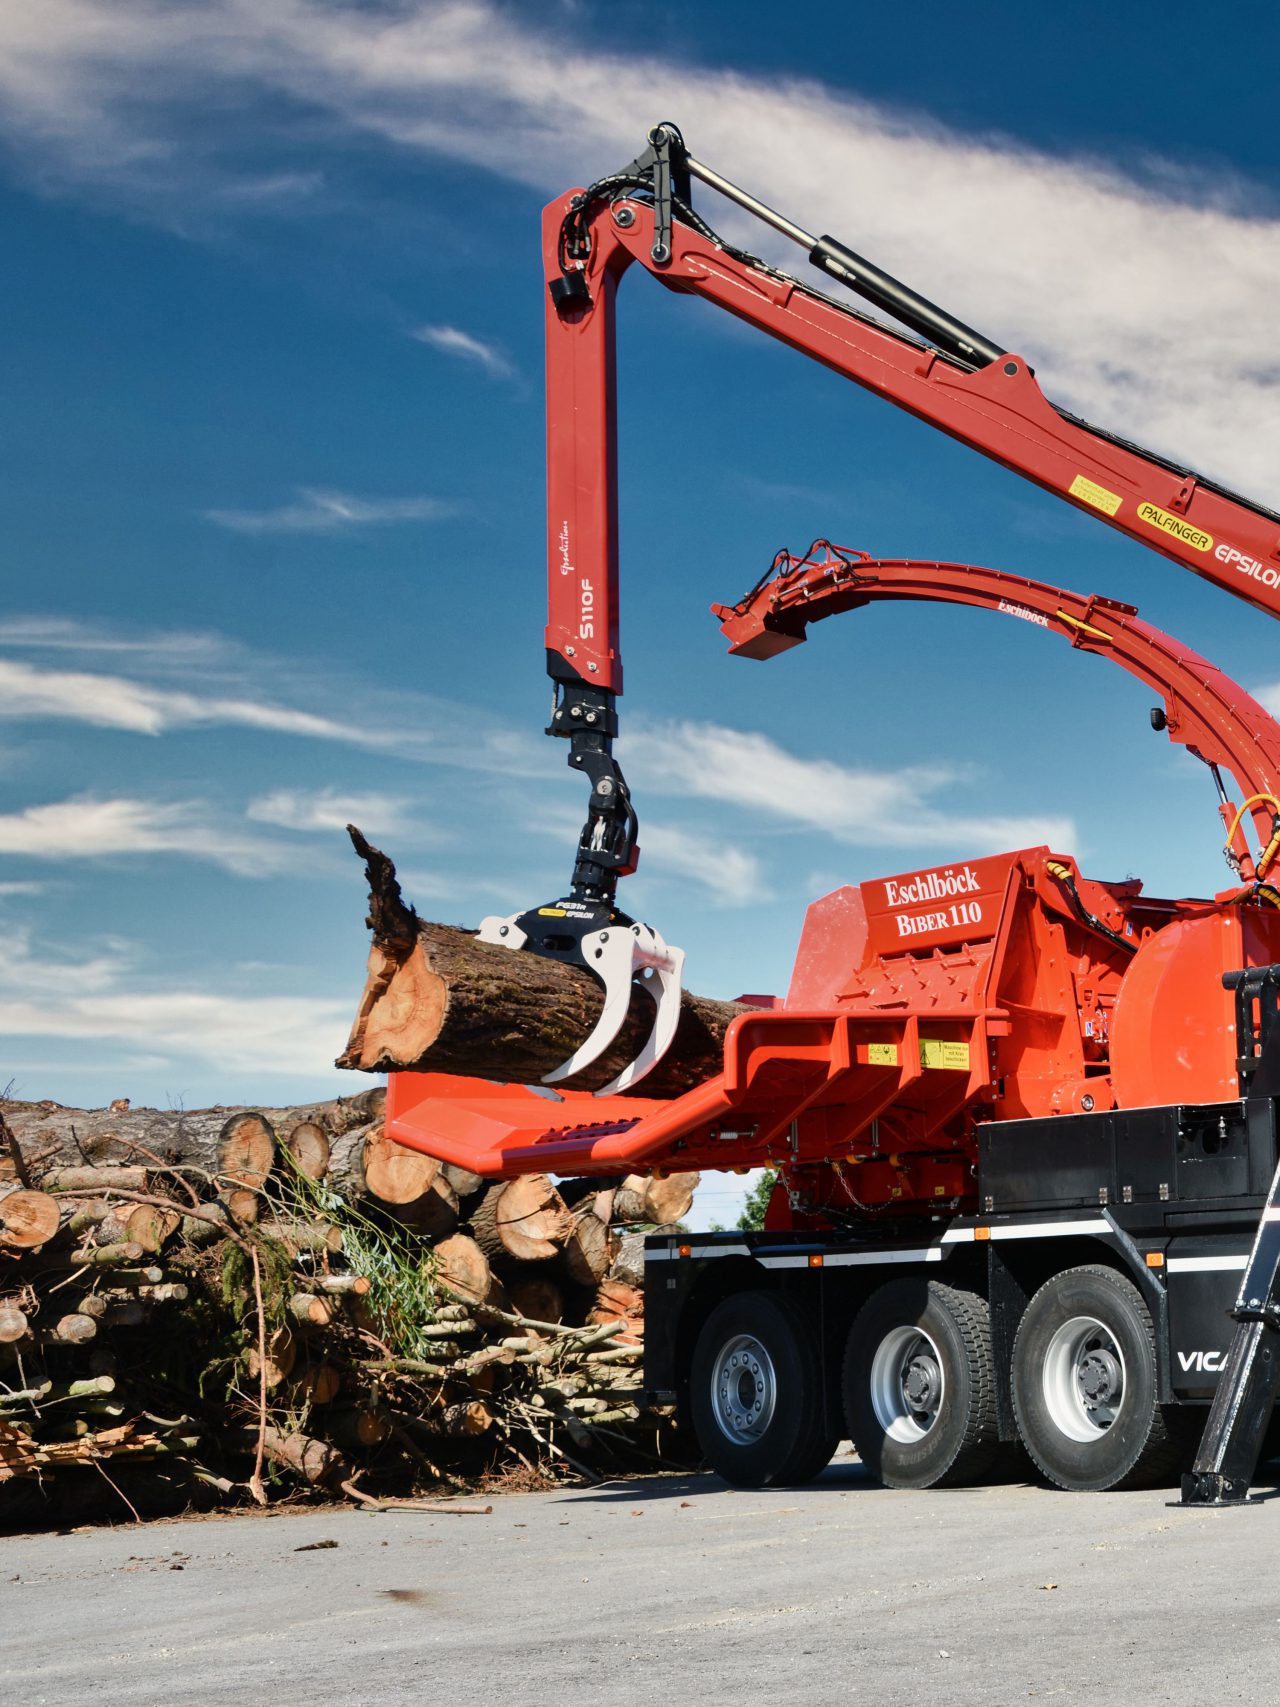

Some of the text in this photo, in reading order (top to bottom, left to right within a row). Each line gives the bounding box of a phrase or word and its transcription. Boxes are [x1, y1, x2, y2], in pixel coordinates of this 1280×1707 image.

[1141, 505, 1209, 549] PALFINGER
[579, 578, 594, 639] S110F
[883, 866, 981, 907] Eschlböck
[566, 911, 595, 919] EPSILON
[895, 901, 982, 937] BIBER 110
